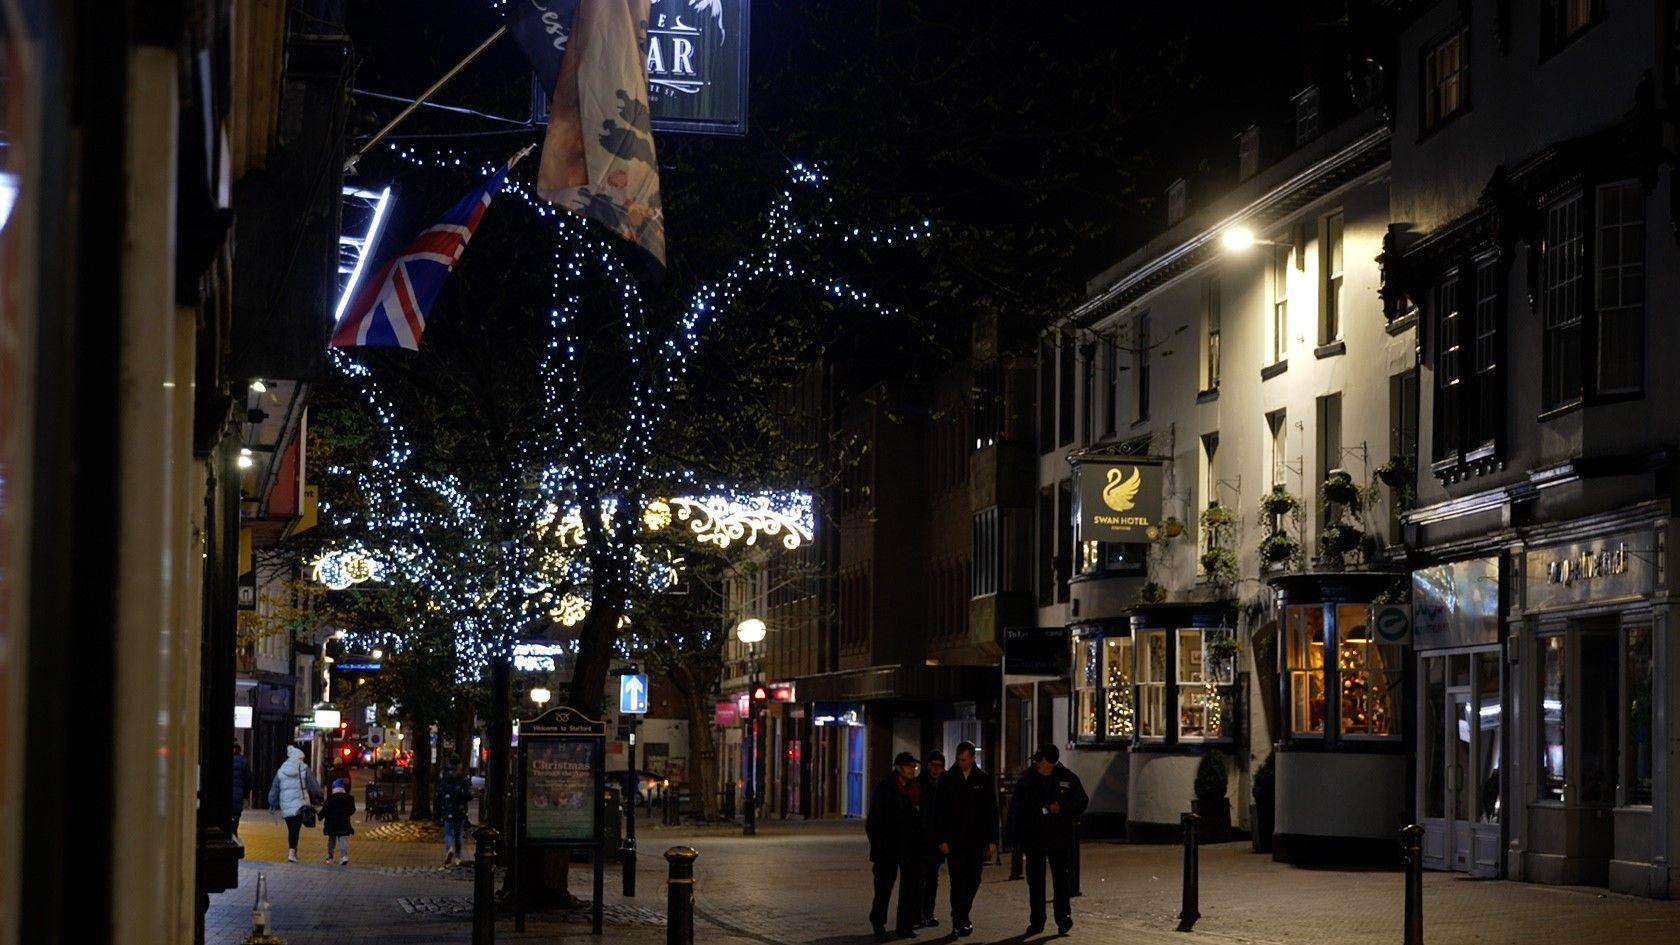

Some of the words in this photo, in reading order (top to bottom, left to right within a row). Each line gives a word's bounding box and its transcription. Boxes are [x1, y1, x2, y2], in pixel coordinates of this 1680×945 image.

[1093, 515, 1119, 525] SWAN
[1120, 516, 1149, 526] HOTEL
[532, 760, 591, 770] Christmas
